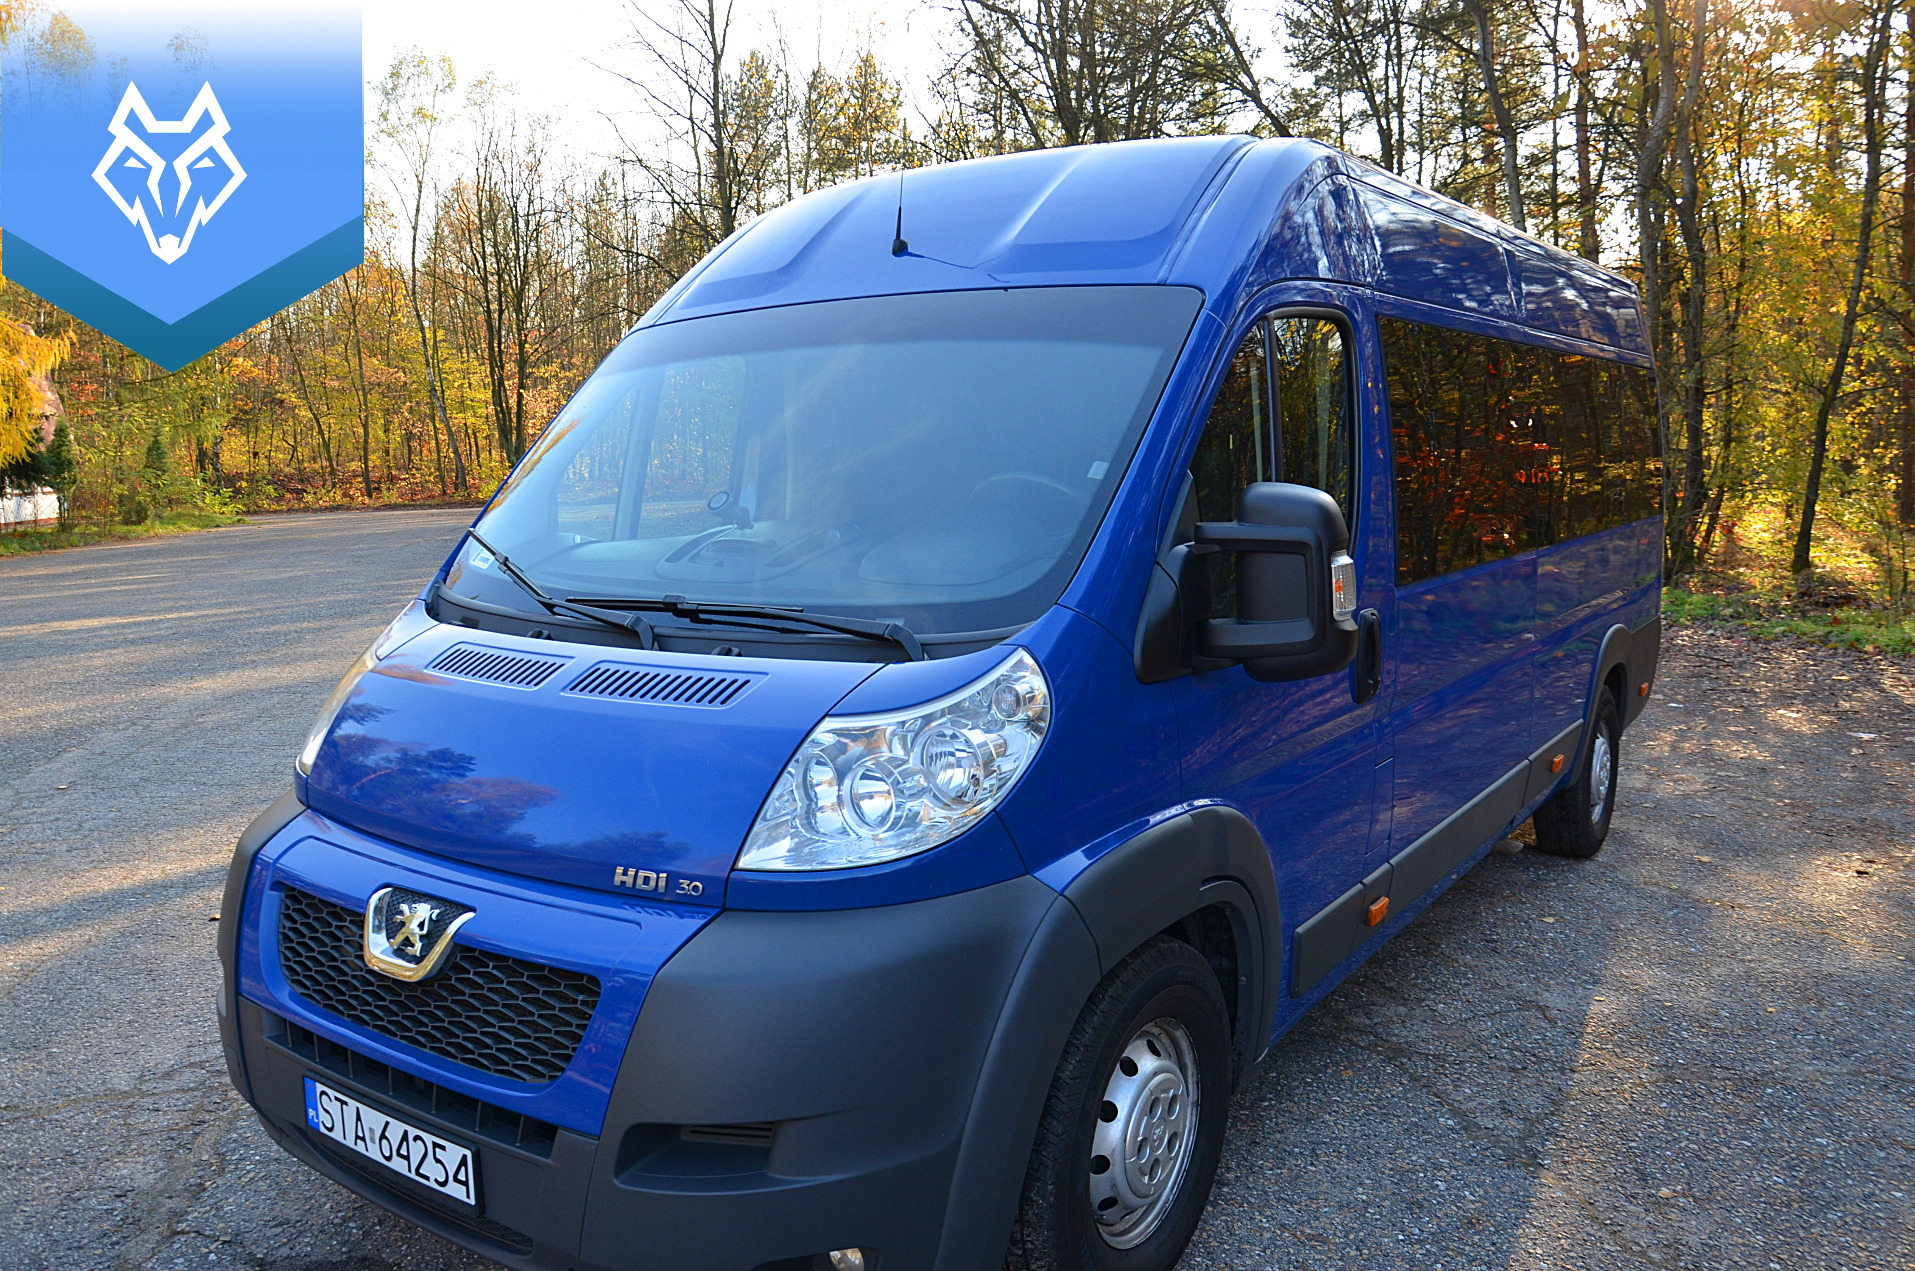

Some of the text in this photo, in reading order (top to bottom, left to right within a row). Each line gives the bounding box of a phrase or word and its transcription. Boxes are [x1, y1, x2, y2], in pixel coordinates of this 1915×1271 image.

[613, 866, 668, 893] HDi
[308, 1108, 319, 1123] PL
[318, 1089, 471, 1200] STA 64254
